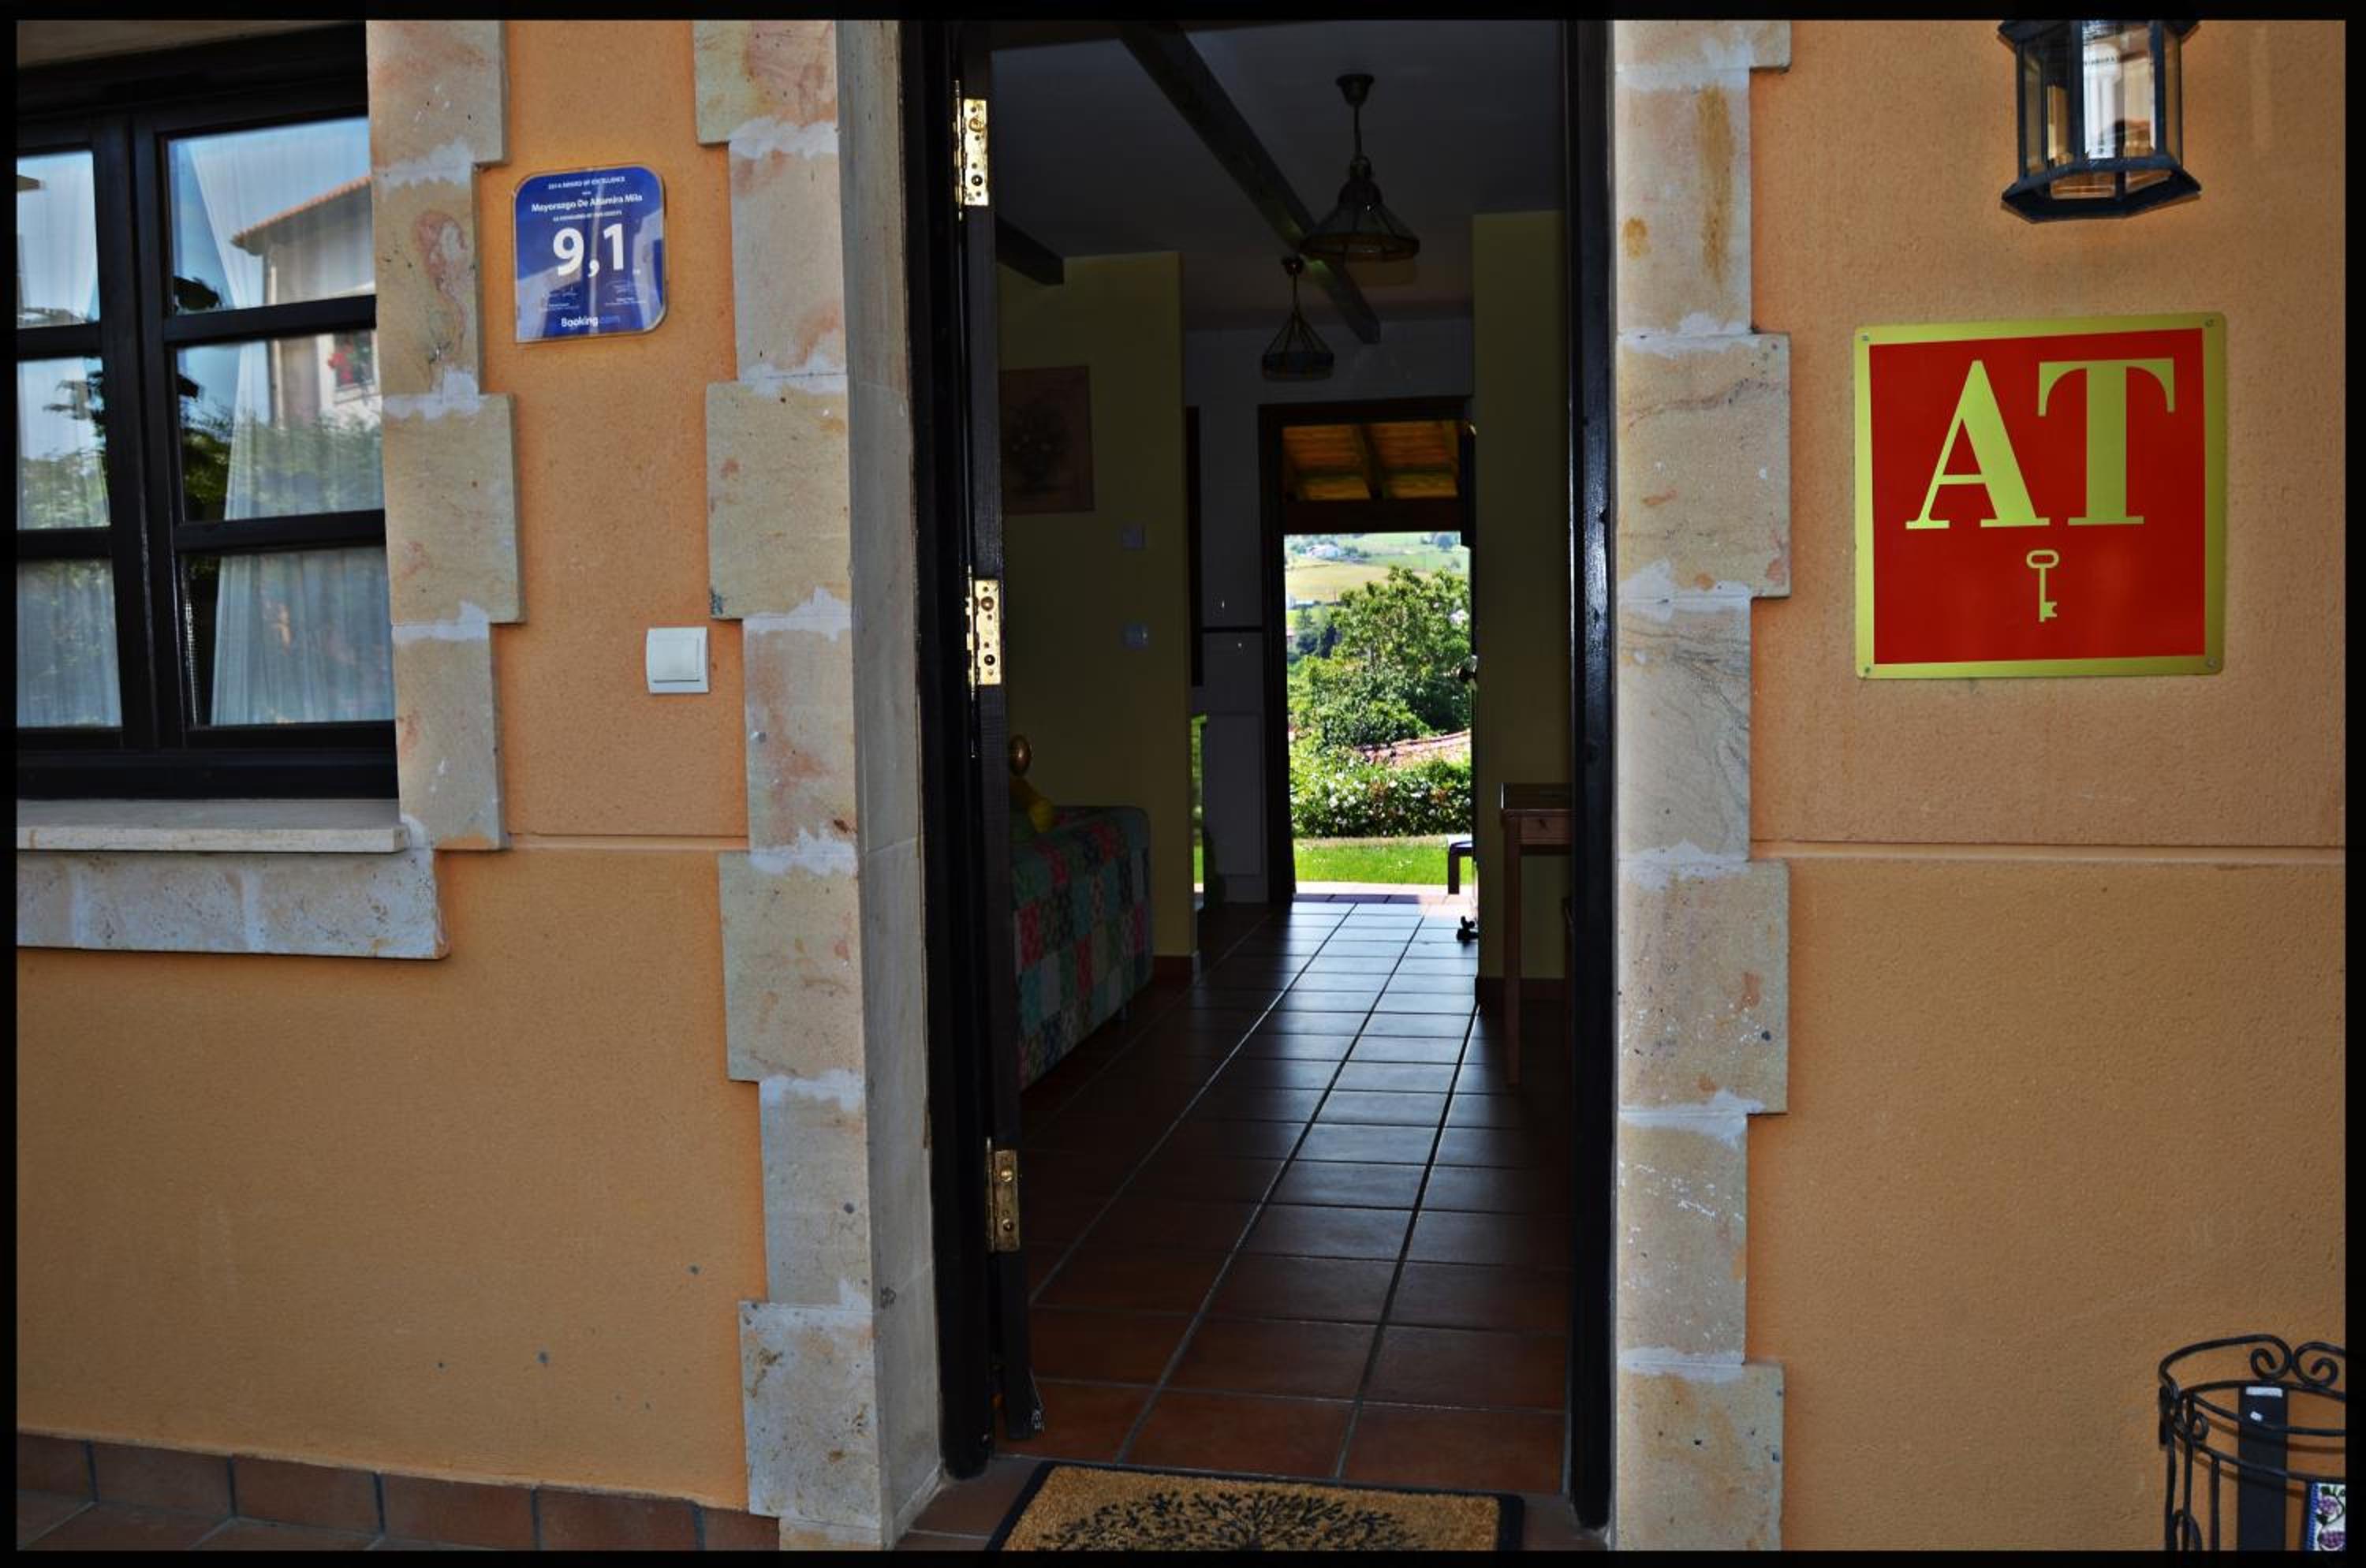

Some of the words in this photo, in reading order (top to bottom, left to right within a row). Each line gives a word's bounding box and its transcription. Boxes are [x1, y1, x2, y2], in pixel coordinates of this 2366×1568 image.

[577, 199, 589, 208] De
[554, 223, 624, 278] 9,1
[1905, 357, 2175, 529] AT
